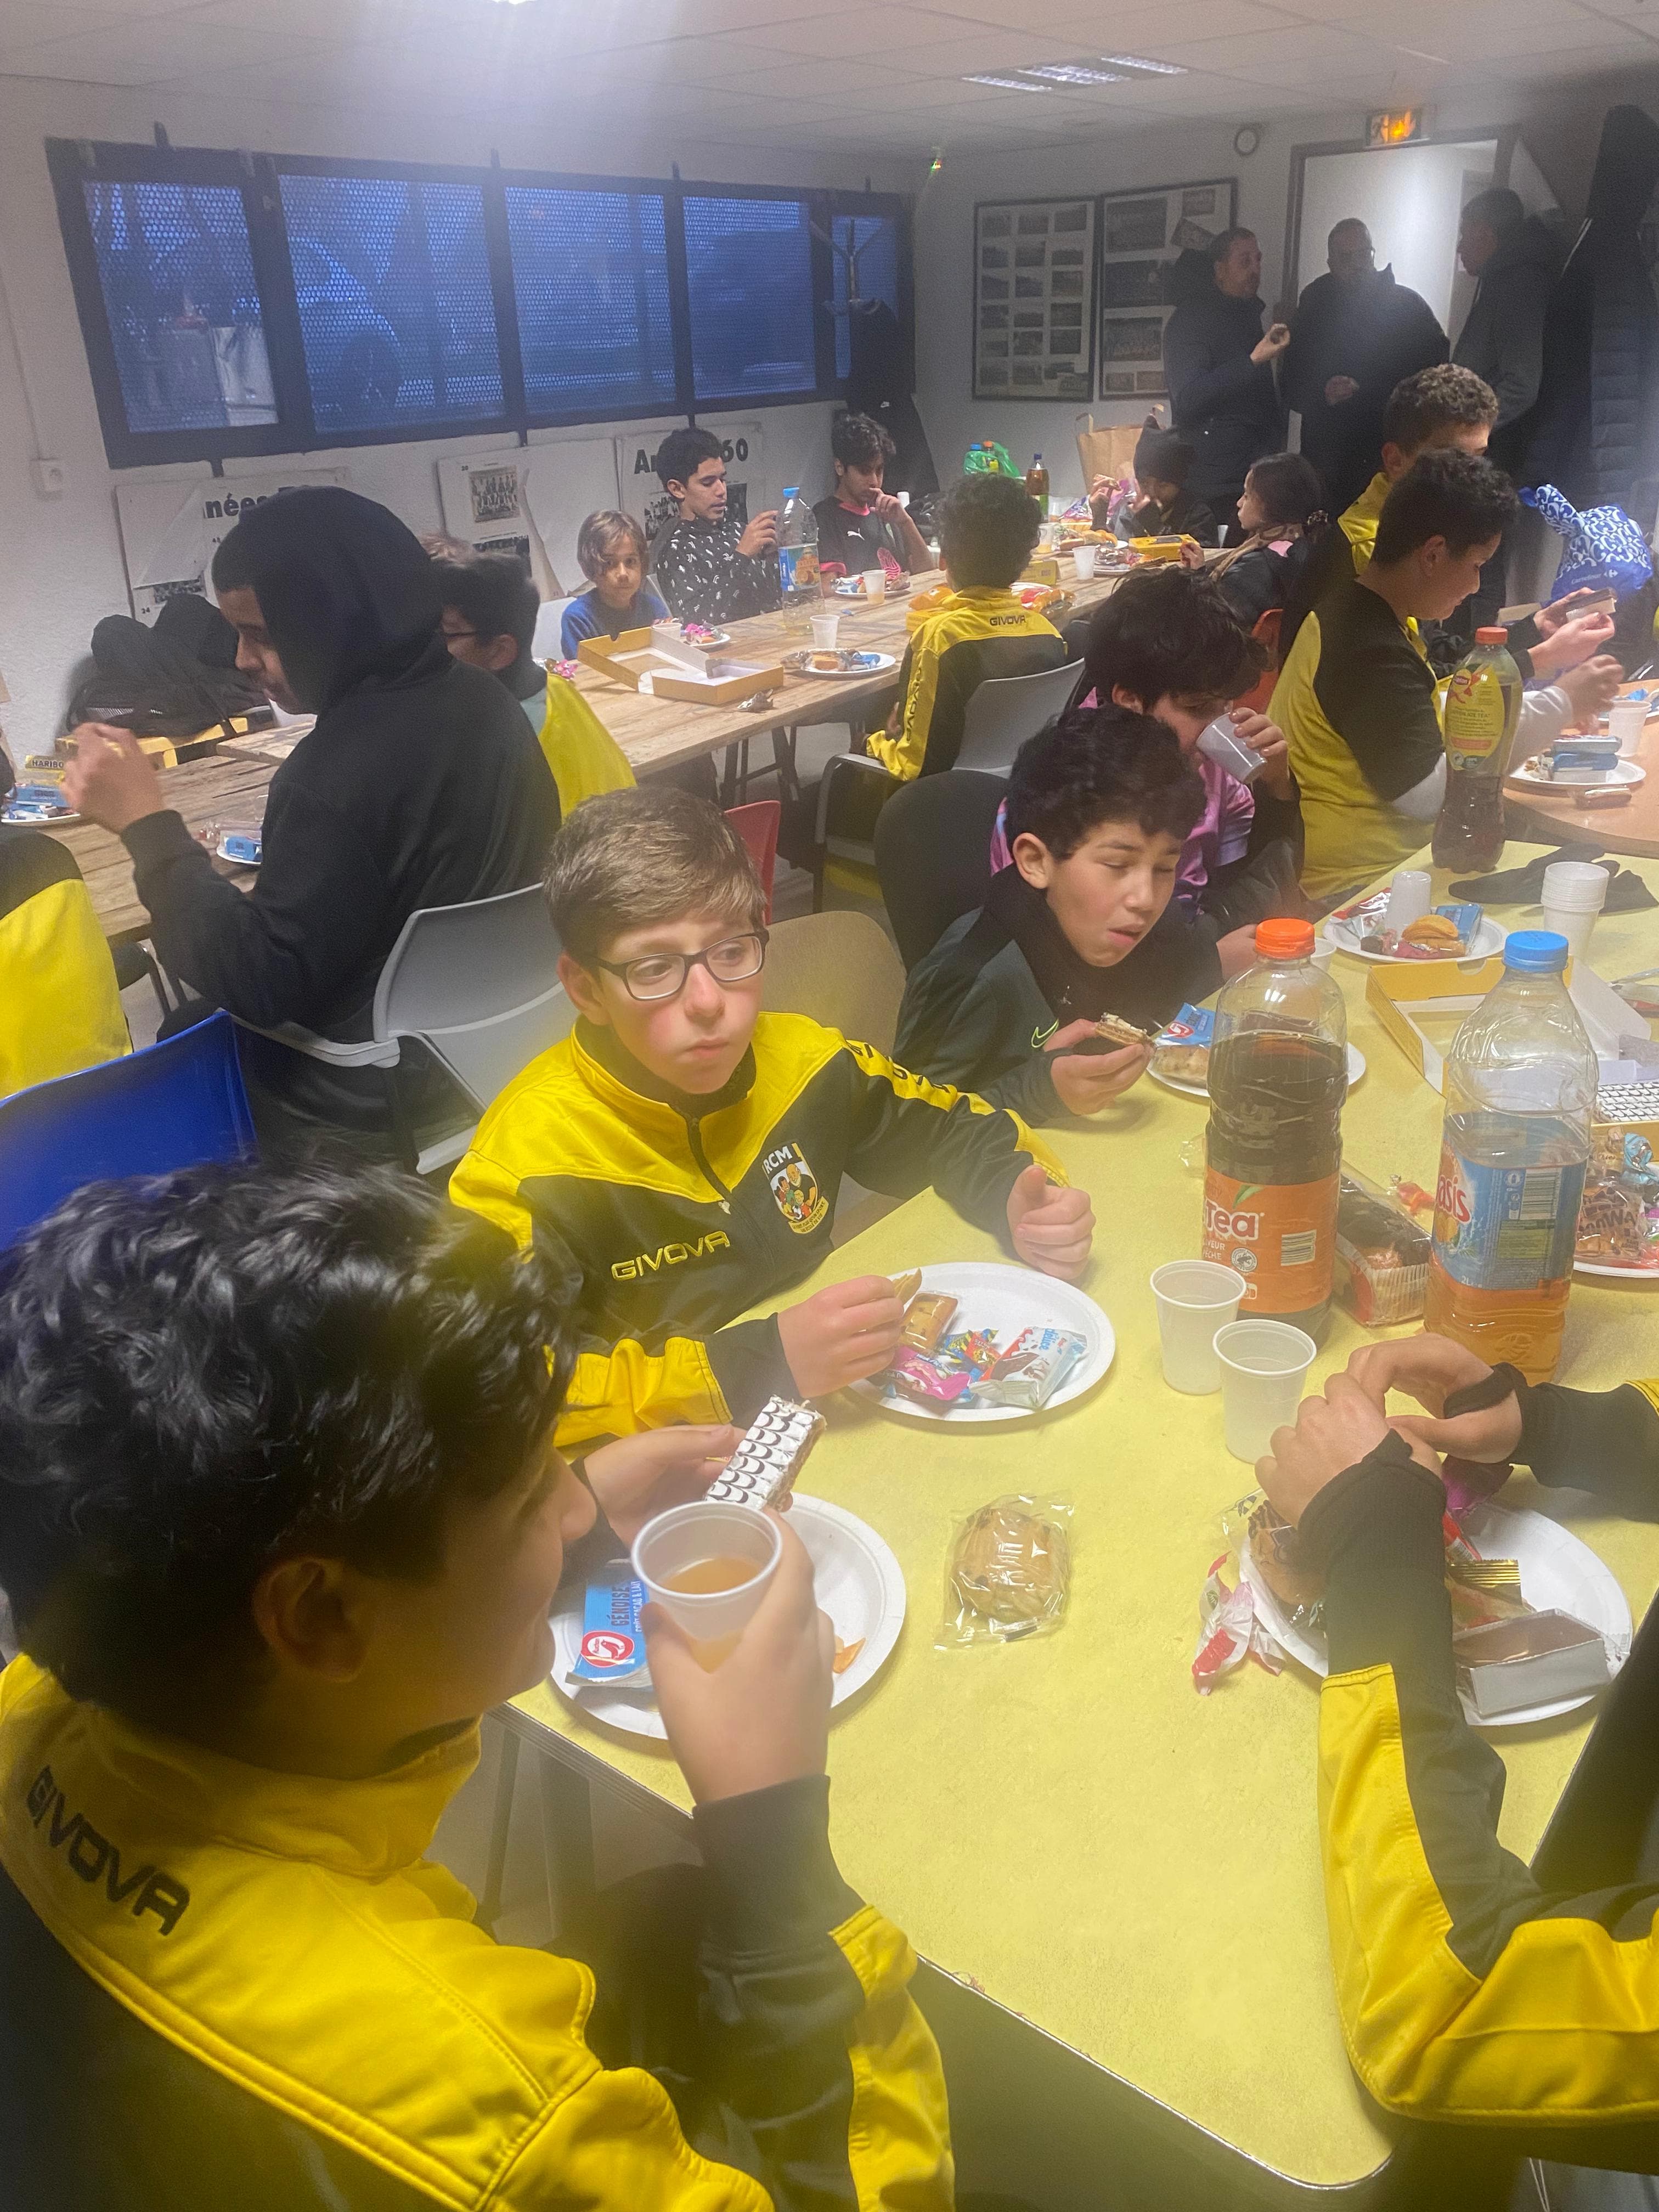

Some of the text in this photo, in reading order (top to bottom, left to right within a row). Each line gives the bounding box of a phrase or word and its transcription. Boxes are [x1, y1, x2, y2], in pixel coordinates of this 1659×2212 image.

[990, 614, 1026, 626] GIVOVA
[32, 759, 64, 768] HARIBO
[763, 1145, 793, 1174] RCM
[611, 1230, 731, 1281] GIVOVA
[606, 1586, 630, 1626] GÉNOISE
[26, 1764, 190, 1936] GIVOVA
